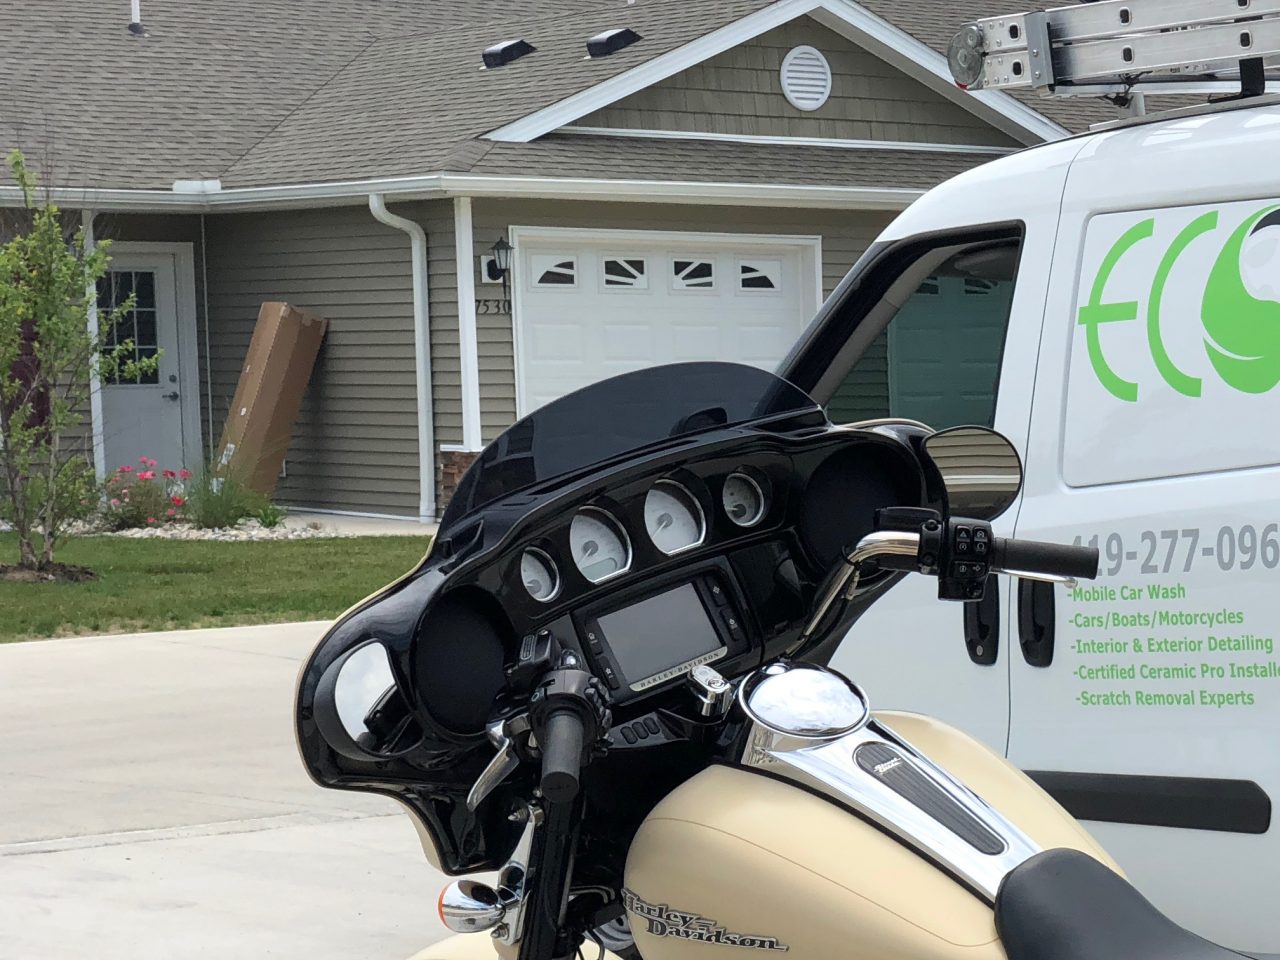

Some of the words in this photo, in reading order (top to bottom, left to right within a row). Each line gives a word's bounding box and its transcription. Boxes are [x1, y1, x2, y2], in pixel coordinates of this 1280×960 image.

[1120, 584, 1143, 600] Car
[1147, 583, 1186, 599] Wash
[1133, 638, 1144, 652] &
[1147, 636, 1203, 652] Exterior
[1207, 635, 1274, 654] Detailing
[640, 652, 719, 688] HARLEY-DAVIDSON
[1139, 663, 1197, 679] Ceramic
[1201, 663, 1225, 678] Pro
[1135, 690, 1195, 705] Removal
[1200, 690, 1255, 708] Experts
[646, 918, 789, 951] Davidson
